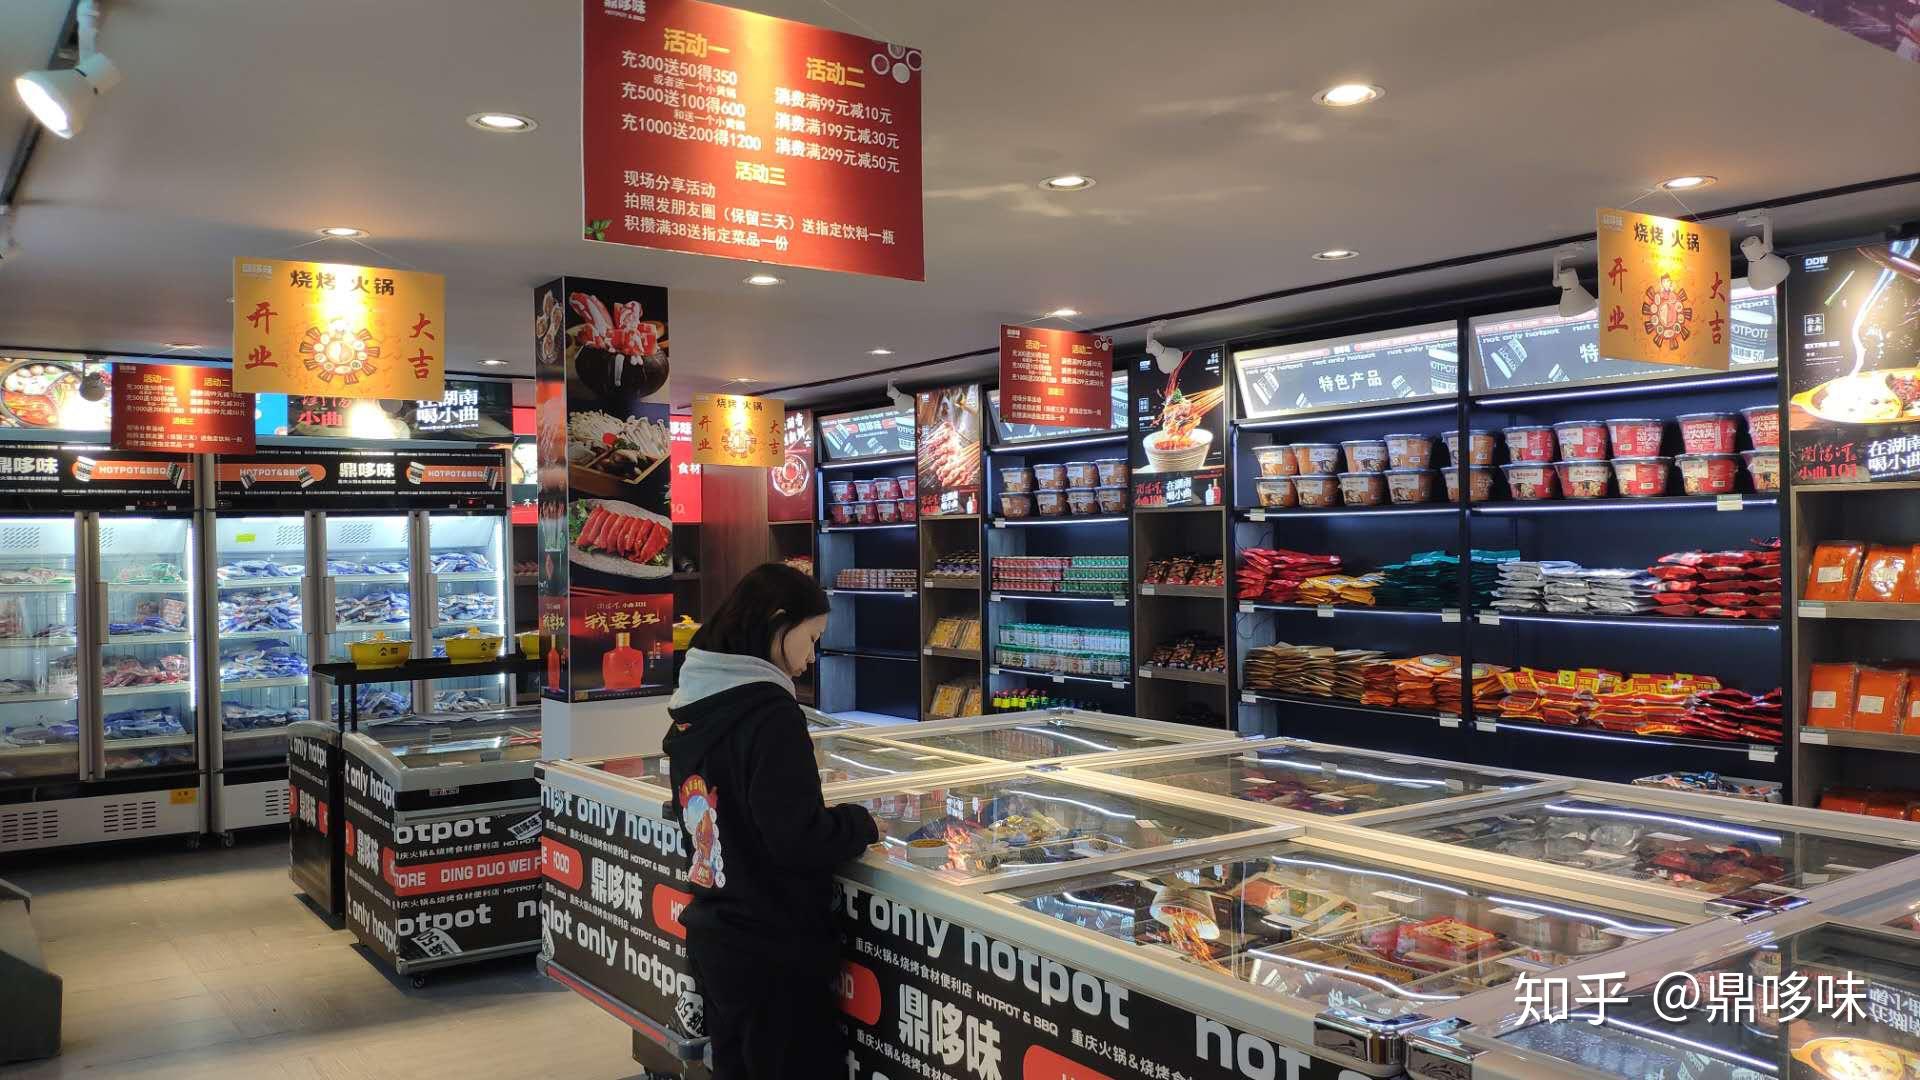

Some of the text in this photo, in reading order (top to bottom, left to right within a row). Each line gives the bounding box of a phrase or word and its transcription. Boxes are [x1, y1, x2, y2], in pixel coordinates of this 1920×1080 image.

[664, 28, 730, 58] 活动一
[621, 50, 737, 85] 充300送50得350
[806, 57, 865, 88] 活动二
[621, 81, 746, 118] 充500送100得600
[774, 86, 893, 125] 消费满99元减10元
[621, 112, 762, 151] 充1000送200得1200
[774, 111, 900, 150] 消费满199元减30元
[735, 160, 786, 186] 活动三
[775, 137, 900, 174] 消费满299元减50元
[624, 170, 716, 198] 现场分享活动
[624, 214, 788, 251] 积攒满38送指定菜品一份
[1634, 222, 1700, 252] 烧烤 火锅
[290, 269, 395, 295] 烧烤 火锅
[1607, 256, 1628, 333] 开业
[1709, 271, 1726, 345] 大吉
[245, 301, 278, 370] 开业
[408, 312, 435, 379] 大吉
[1318, 368, 1382, 393] 特色产品
[298, 411, 343, 427] 小曲
[768, 419, 781, 456] 大吉
[1867, 435, 1920, 458] 在湖南
[339, 462, 395, 479] 鼎哆味
[583, 610, 661, 633] 我要红
[351, 764, 368, 797] only
[395, 817, 491, 844] otpot
[577, 797, 619, 836] only
[441, 864, 473, 883] DING
[477, 860, 505, 878] DUO
[508, 856, 531, 874] WEI
[591, 856, 643, 919] 鼎哆味
[353, 902, 370, 934] only
[396, 903, 491, 938] otpot
[577, 922, 618, 967] only
[869, 894, 950, 959] only
[963, 925, 1130, 1031] hotpot
[856, 936, 973, 1000] 重庆火锅&烧烤食材便利店
[976, 990, 1021, 1020] HOTPOT
[1022, 1010, 1032, 1026] &
[1033, 1014, 1059, 1038] BBQ
[898, 983, 1002, 1080] 鼎哆味
